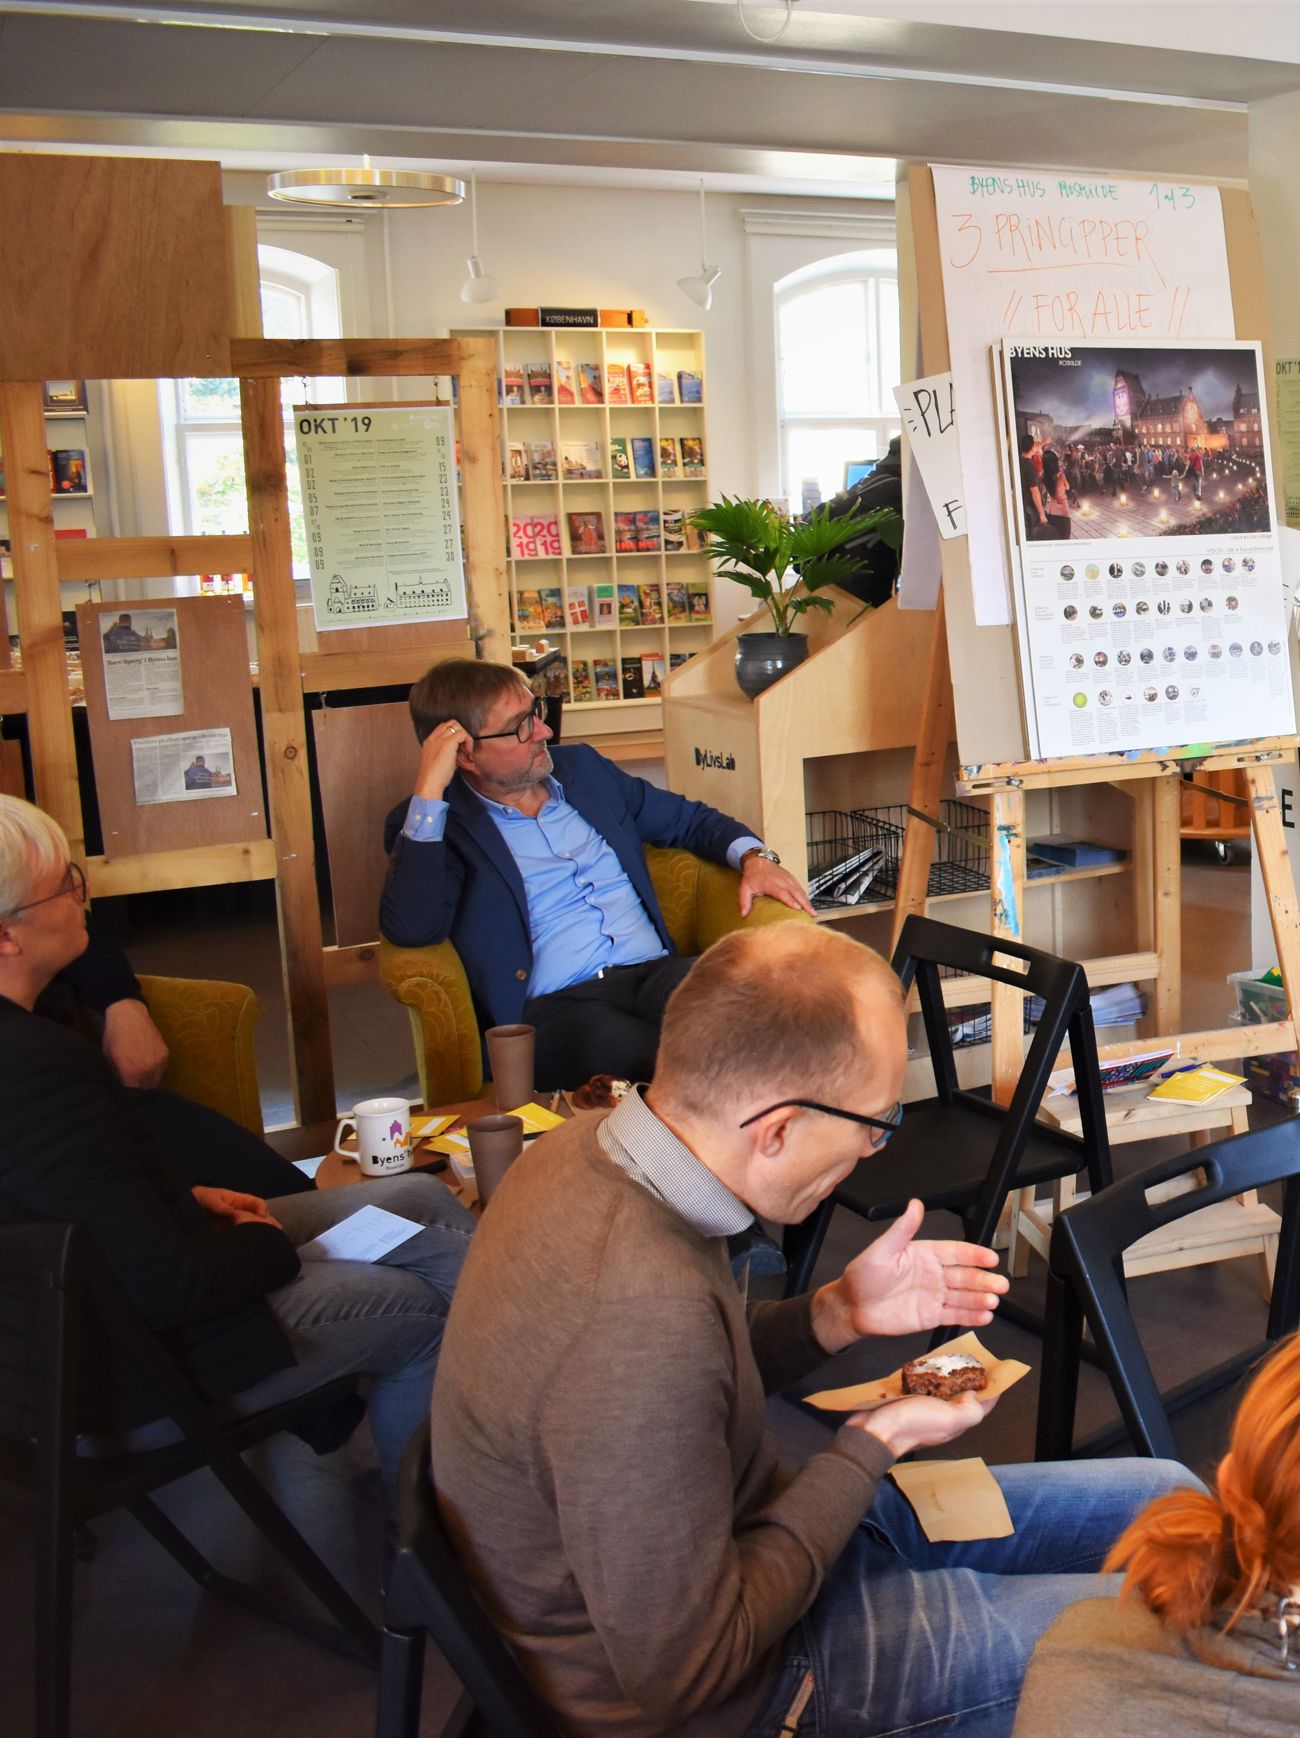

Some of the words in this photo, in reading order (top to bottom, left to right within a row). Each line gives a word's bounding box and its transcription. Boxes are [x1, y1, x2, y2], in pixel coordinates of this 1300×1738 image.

[1016, 178, 1046, 197] HUS
[1149, 183, 1160, 209] 1
[1180, 187, 1197, 208] 3
[950, 214, 982, 268] 3
[545, 315, 594, 324] KØBENHAVN
[1032, 291, 1086, 338] FOR
[1091, 290, 1154, 334] ALLE
[1009, 346, 1046, 359] BYENS
[1048, 346, 1072, 359] HUS
[1276, 361, 1292, 375] OKT
[299, 418, 339, 435] OKT
[694, 747, 736, 771] ByLivsLab
[371, 1155, 405, 1168] Byens
